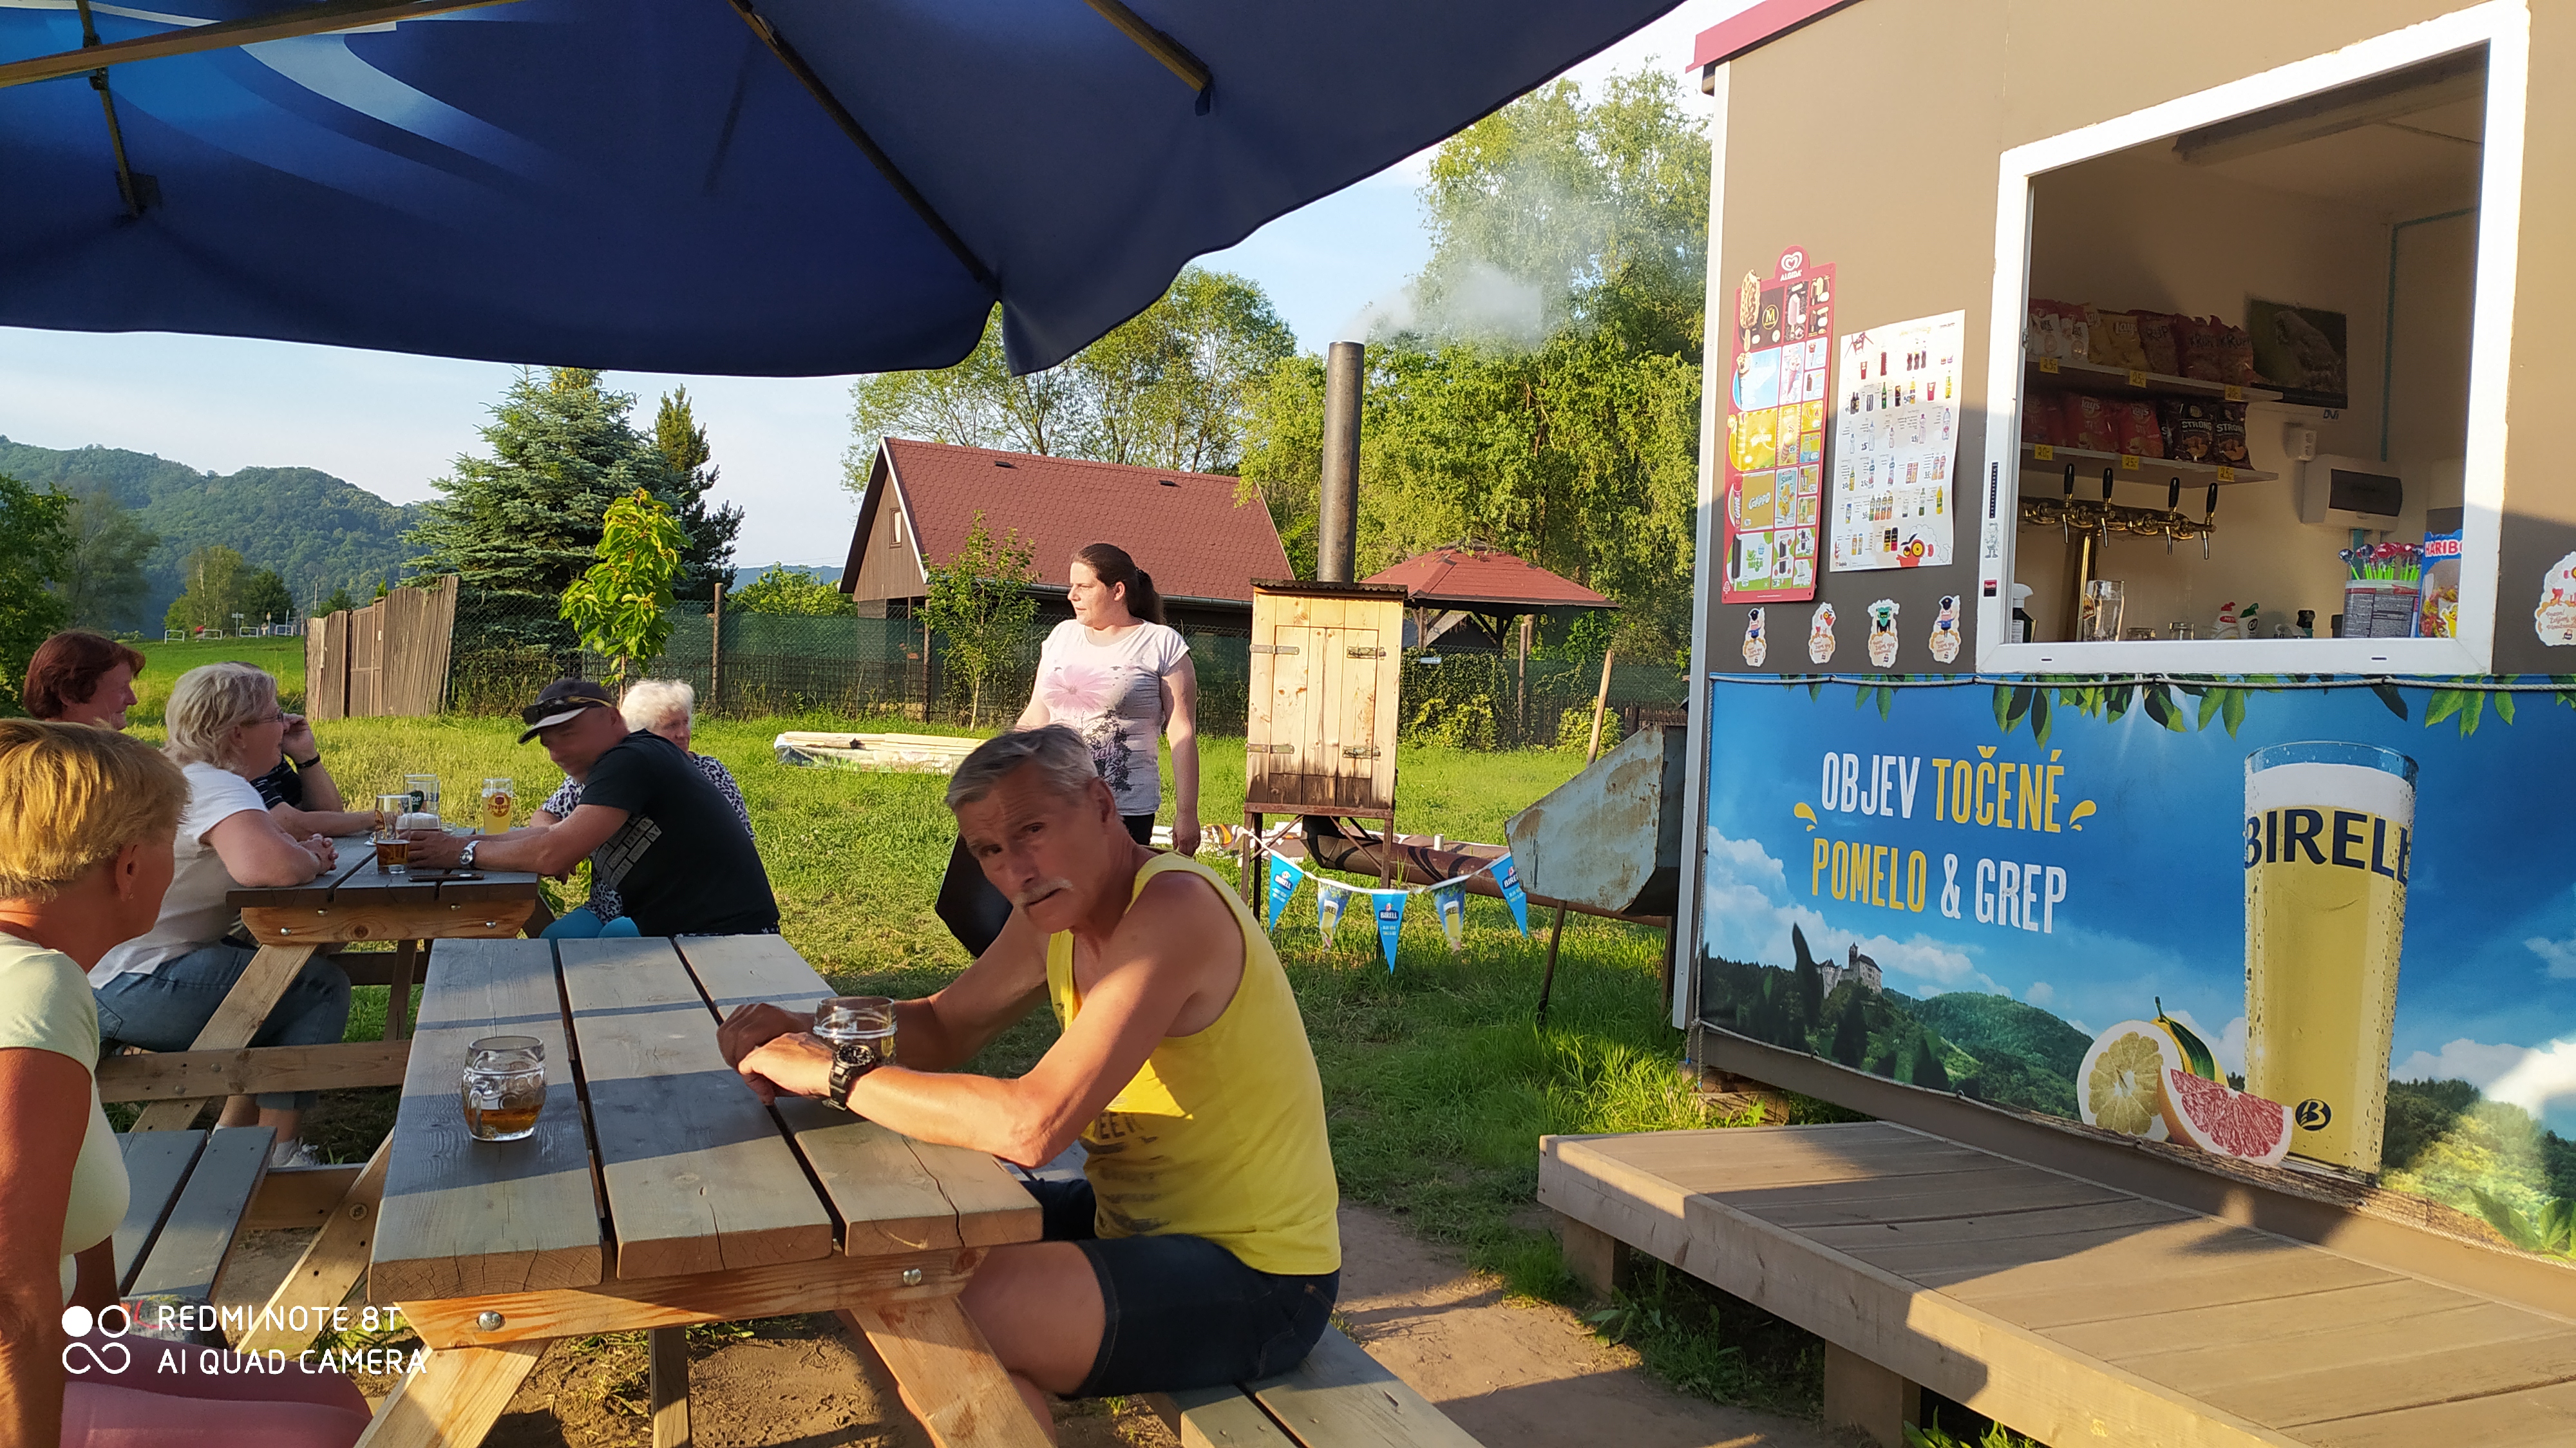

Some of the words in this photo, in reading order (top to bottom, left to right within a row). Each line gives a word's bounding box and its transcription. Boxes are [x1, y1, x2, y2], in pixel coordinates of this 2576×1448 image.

[1780, 271, 1802, 281] ALGIDA
[2181, 420, 2212, 431] STRONG
[2425, 540, 2463, 557] HARIB
[1822, 751, 1920, 819] OBJEV
[1932, 745, 2065, 833] TOČENÉ
[1812, 837, 1927, 913] POMELO
[1941, 853, 1961, 920] &
[1975, 858, 2067, 934] GREP
[1380, 911, 1398, 920] BIRELL
